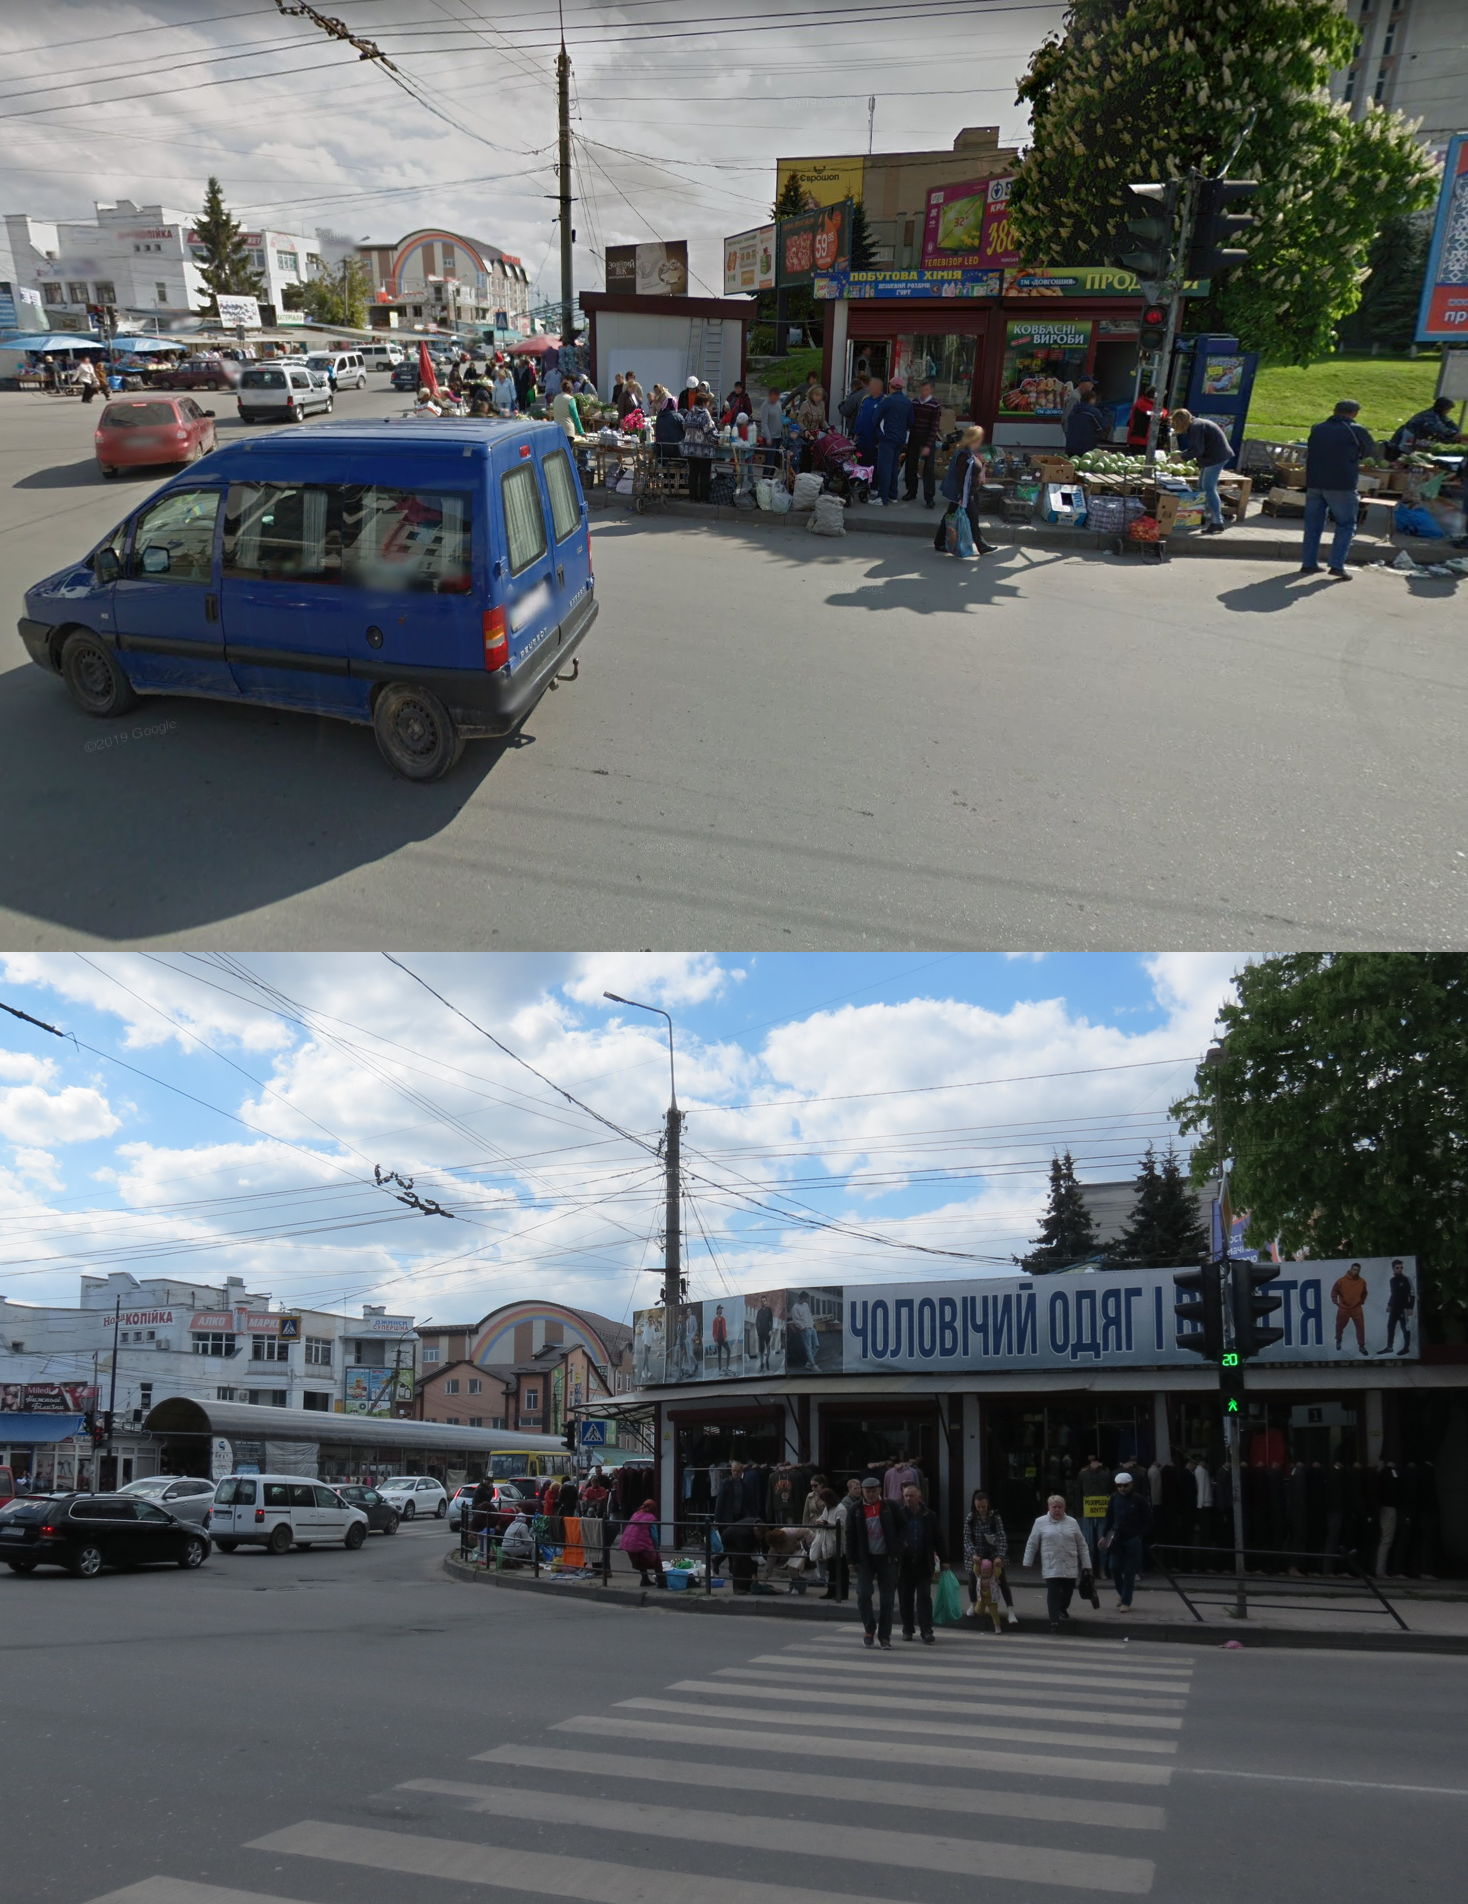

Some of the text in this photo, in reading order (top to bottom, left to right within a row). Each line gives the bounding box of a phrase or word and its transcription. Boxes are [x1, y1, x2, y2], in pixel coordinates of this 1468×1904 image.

[815, 233, 828, 259] 59
[924, 255, 979, 267] ТЕЛЕВІЗОР LED
[850, 270, 963, 282] ПОБУТОВА ХІМІЯ
[1085, 273, 1199, 293] ПРОДИ
[1013, 324, 1076, 335] КОВБАСНІ
[1033, 334, 1085, 344] ВИРОБИ
[520, 626, 548, 659] PEUGEOT
[125, 1309, 173, 1326] КОПІЙКА
[198, 1316, 281, 1329] АЛКО МАРКЕ
[850, 1278, 1324, 1361] ЧОЛОВІЧИЙ ОДЯГ І ВТТЯ
[1222, 1353, 1239, 1367] 20
[28, 1387, 52, 1395] Miledi
